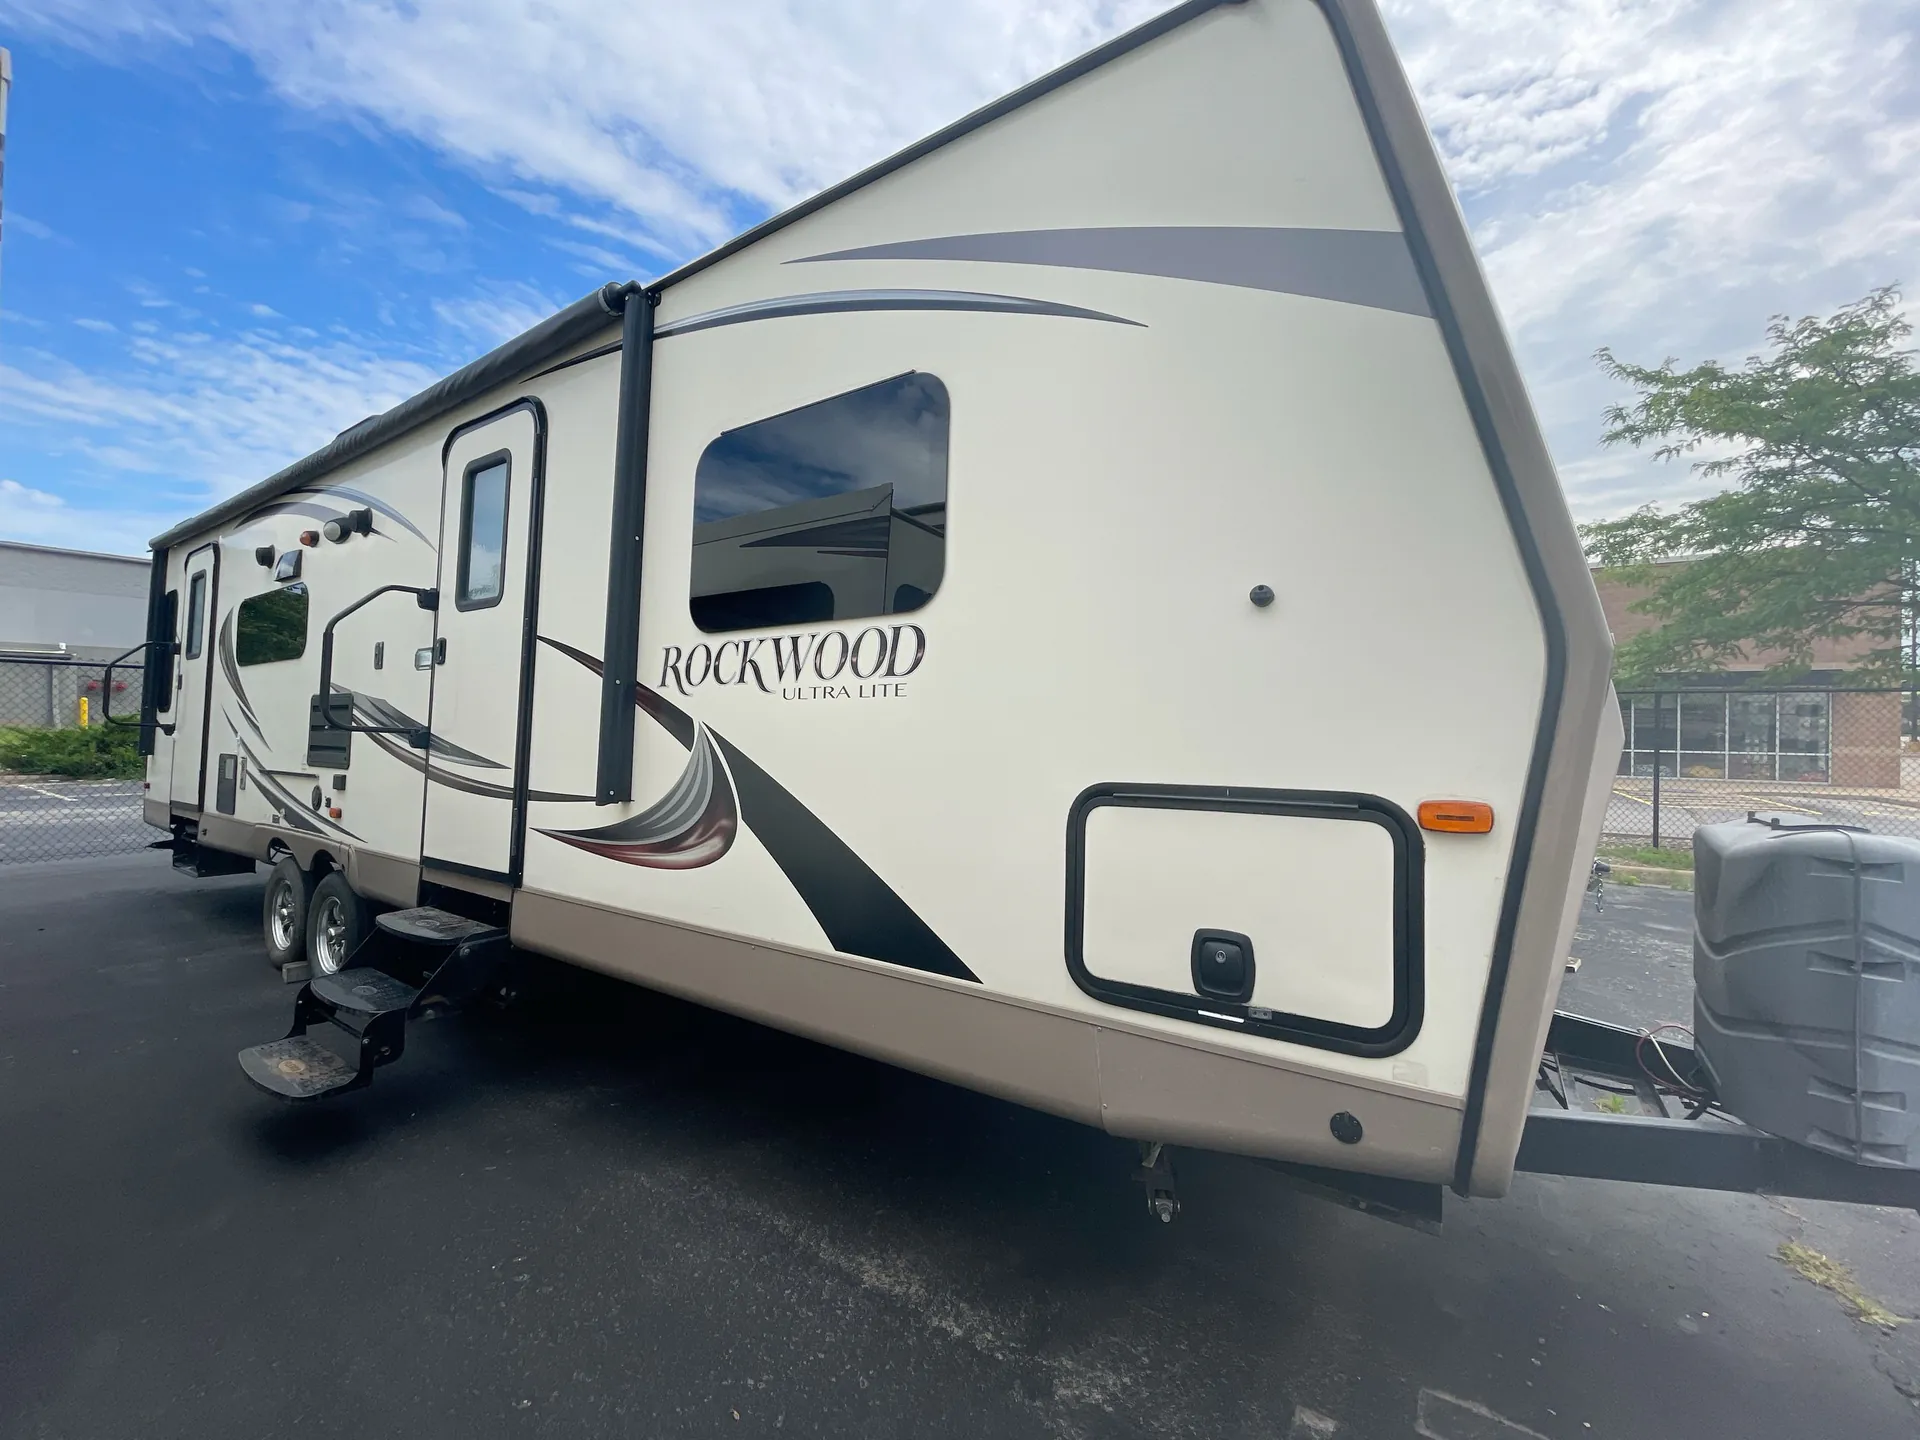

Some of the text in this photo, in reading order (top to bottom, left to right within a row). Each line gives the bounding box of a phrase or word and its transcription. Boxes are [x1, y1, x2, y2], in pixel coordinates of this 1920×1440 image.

[657, 623, 926, 697] ROCKWOOD
[783, 683, 908, 701] ULTRA LITE
